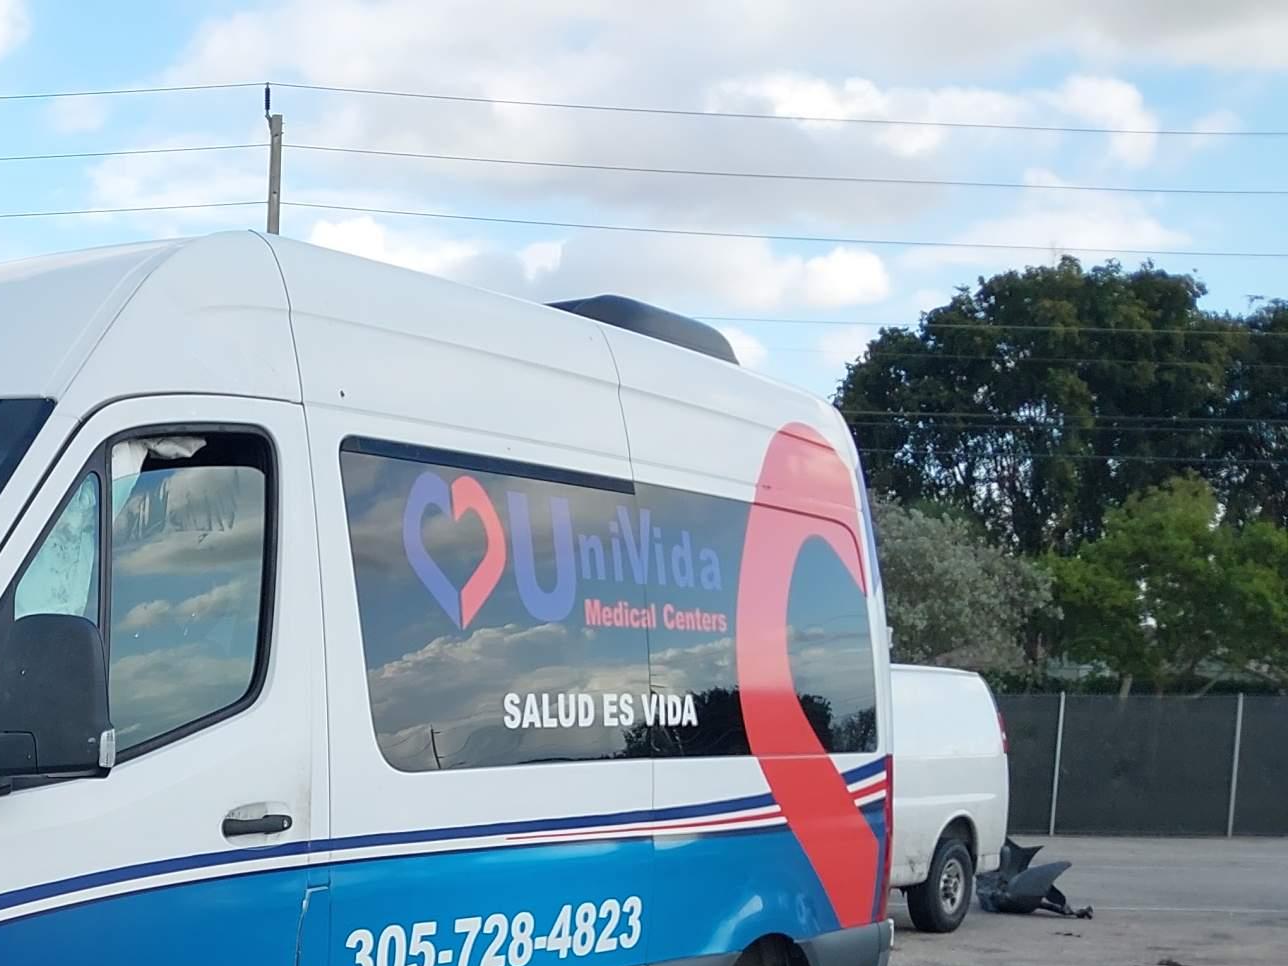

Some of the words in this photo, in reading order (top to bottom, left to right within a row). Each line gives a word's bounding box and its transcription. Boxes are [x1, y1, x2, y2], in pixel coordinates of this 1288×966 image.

[506, 491, 722, 622] UniVida
[584, 598, 656, 629] Medical
[663, 603, 728, 632] Centers
[503, 692, 595, 729] SALUD
[603, 693, 634, 727] ES
[641, 694, 698, 727] VIDA
